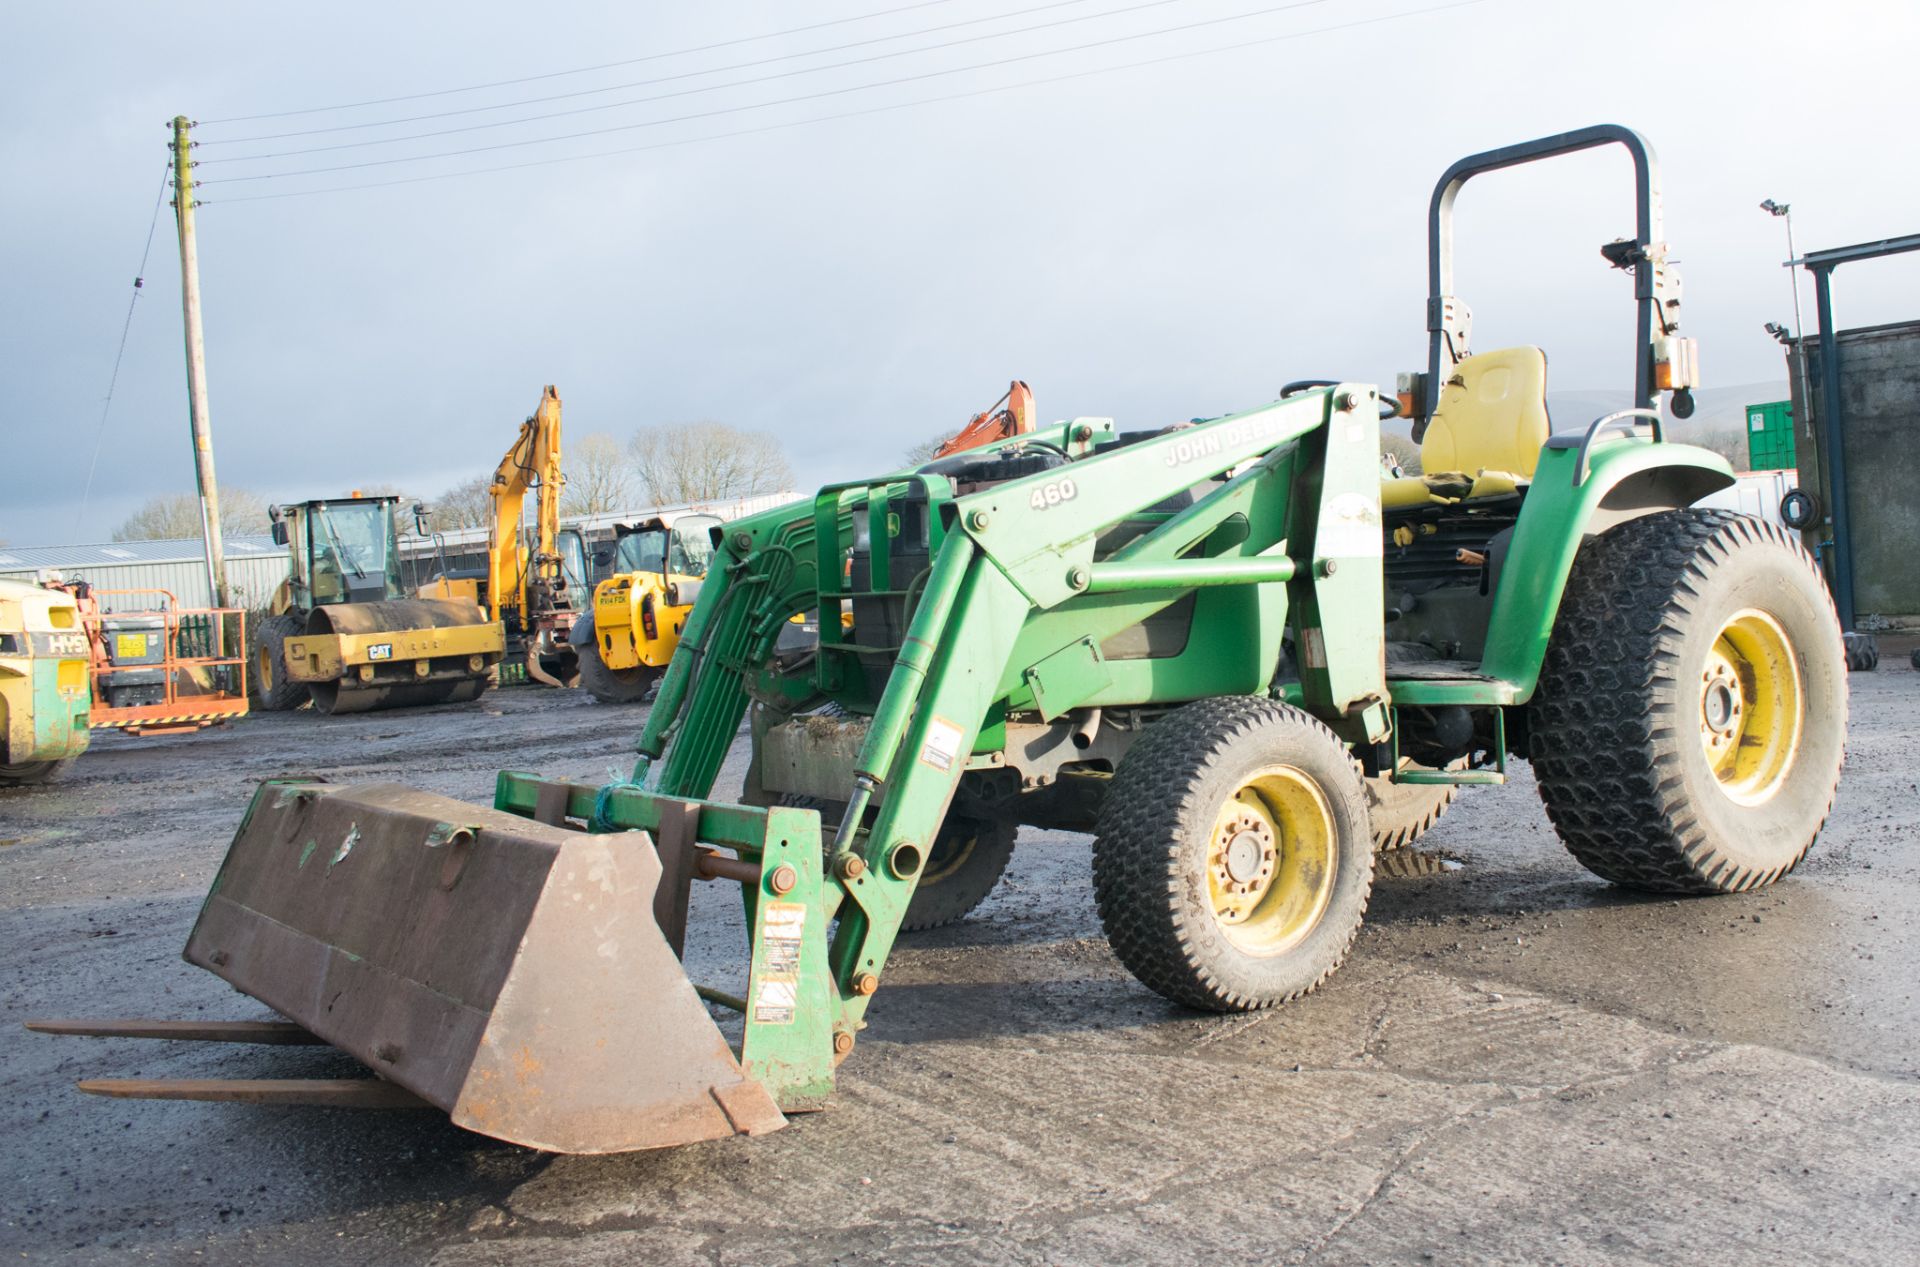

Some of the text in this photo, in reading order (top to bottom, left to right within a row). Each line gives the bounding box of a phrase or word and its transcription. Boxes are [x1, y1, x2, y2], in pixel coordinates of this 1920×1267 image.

[1165, 433, 1222, 467] JOHN
[1030, 477, 1078, 510] 460
[369, 645, 391, 659] CAT
